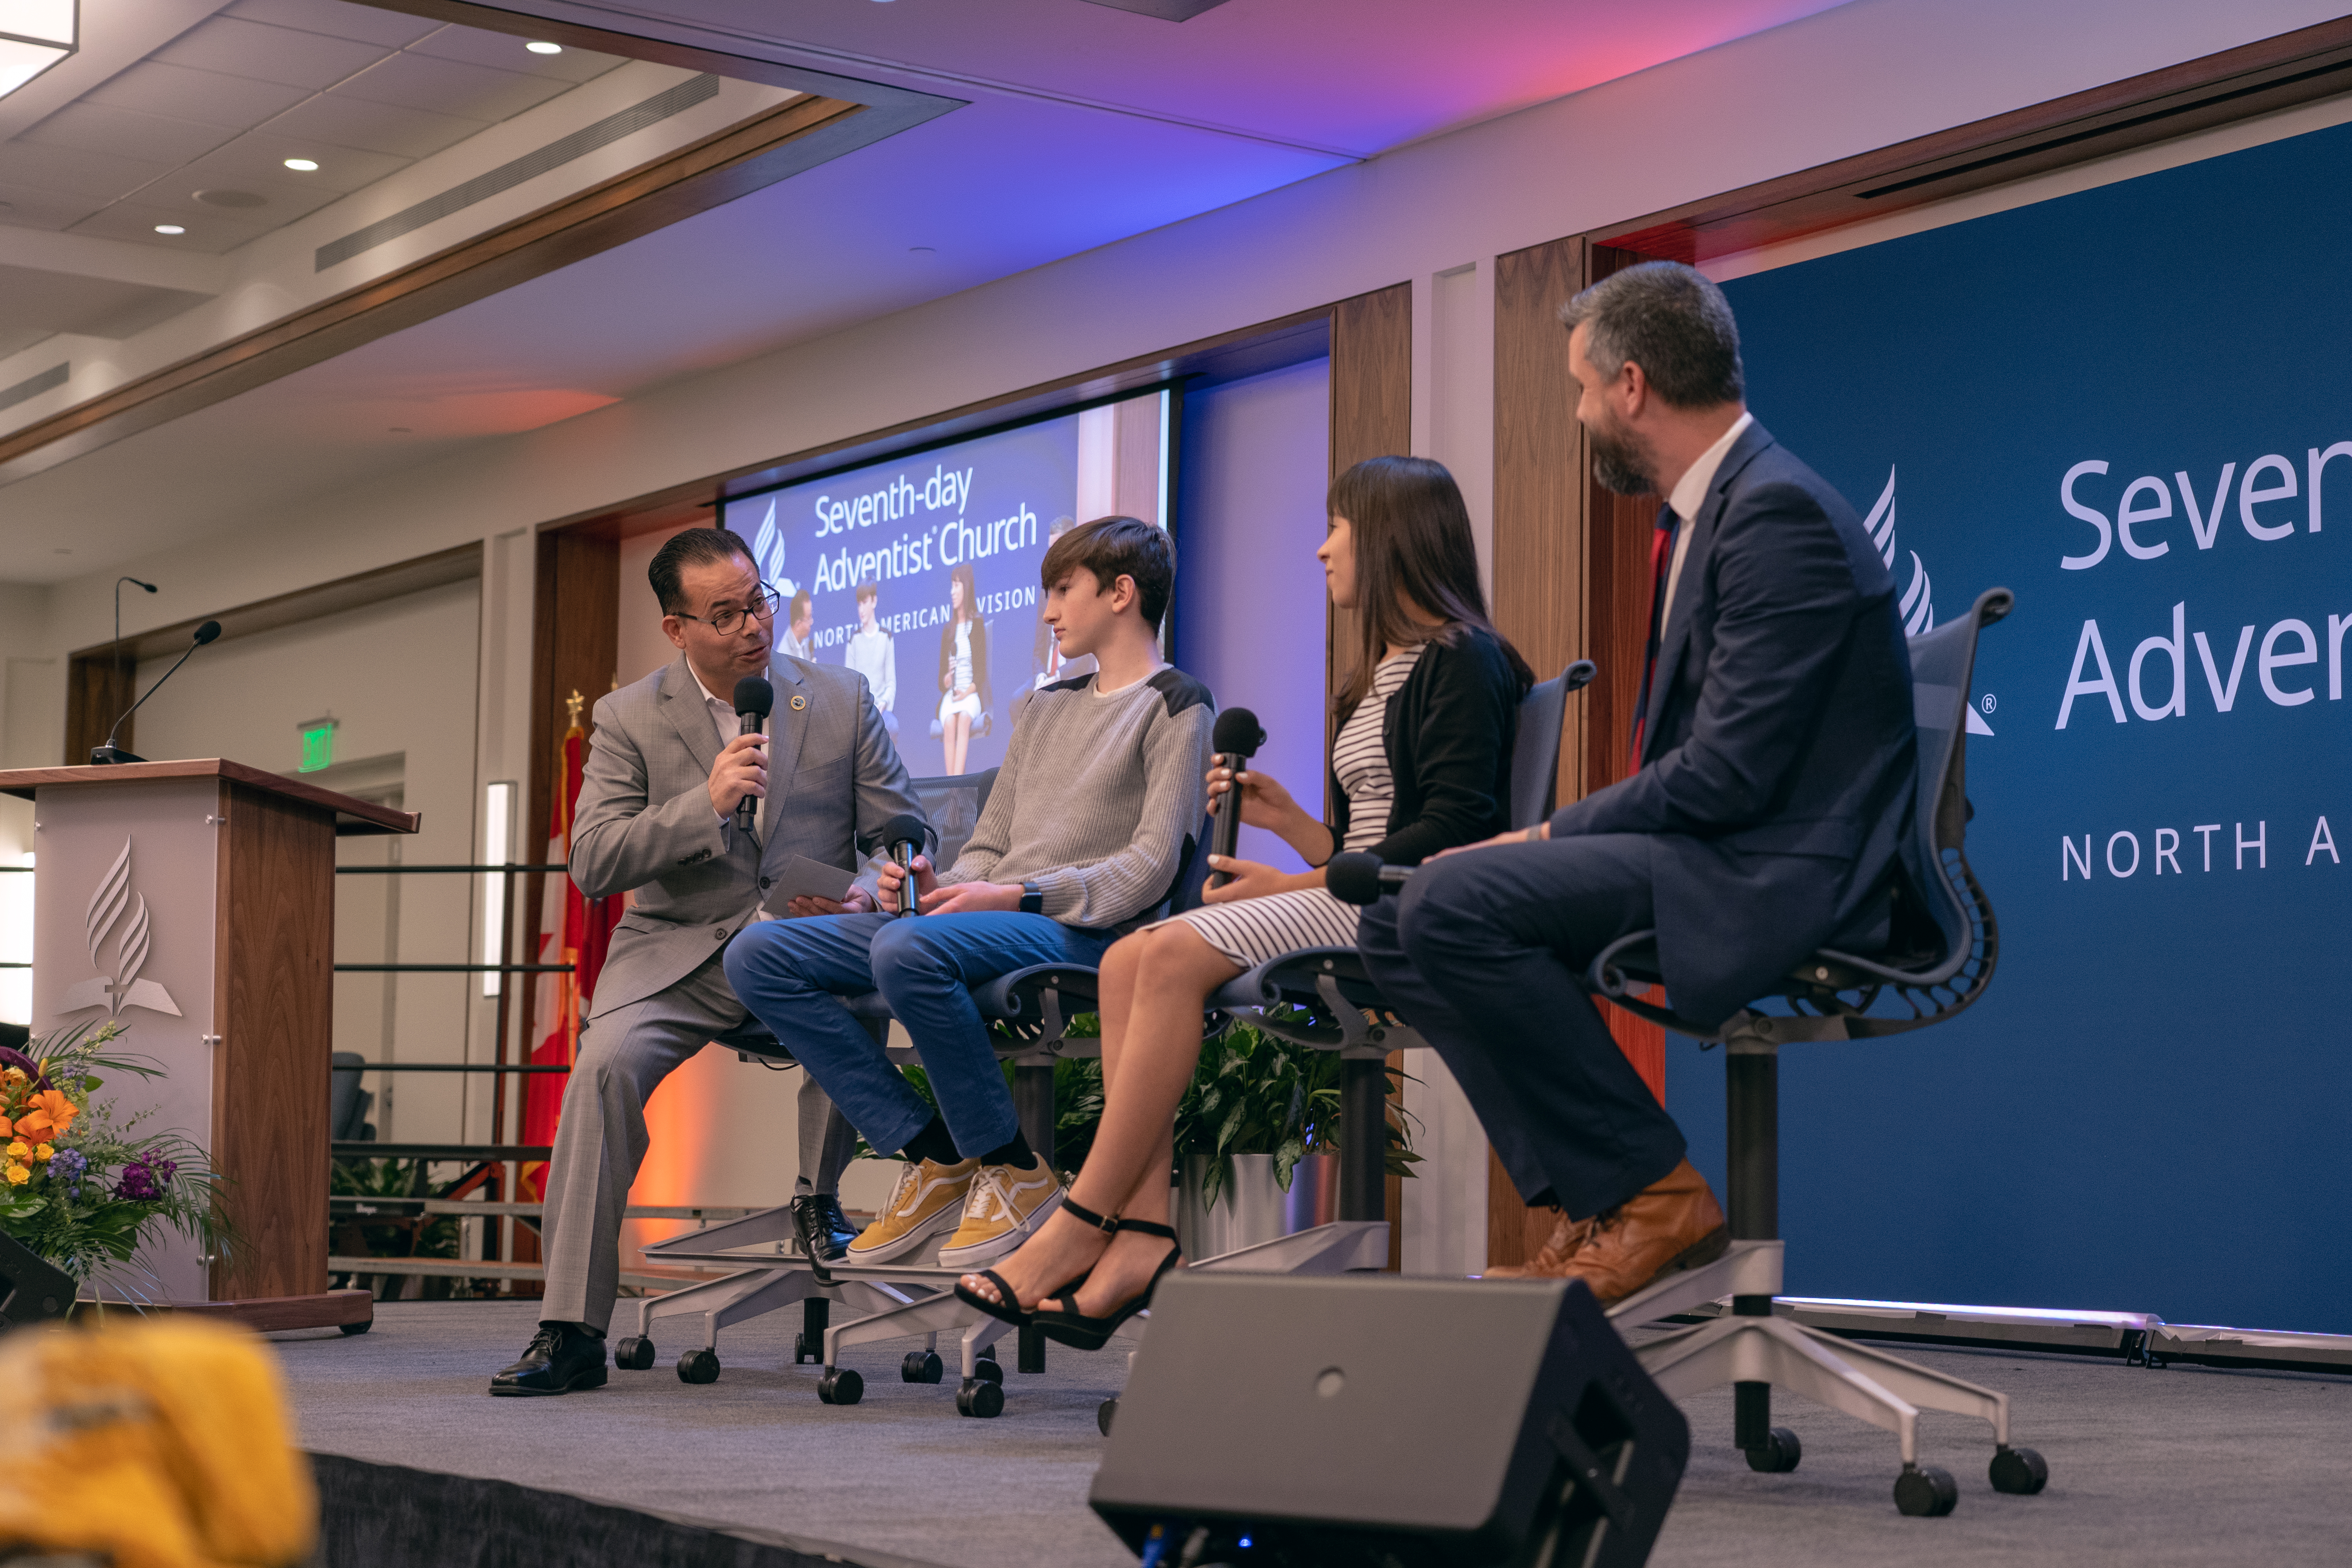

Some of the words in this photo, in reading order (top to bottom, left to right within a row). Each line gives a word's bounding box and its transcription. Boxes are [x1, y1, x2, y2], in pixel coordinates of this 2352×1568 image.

[815, 464, 973, 538] Seventh-day
[940, 502, 1037, 566] Church
[814, 622, 863, 649] NORT
[880, 604, 950, 633] MERICAN
[976, 585, 1035, 614] VISION
[2062, 820, 2266, 881] NORTH
